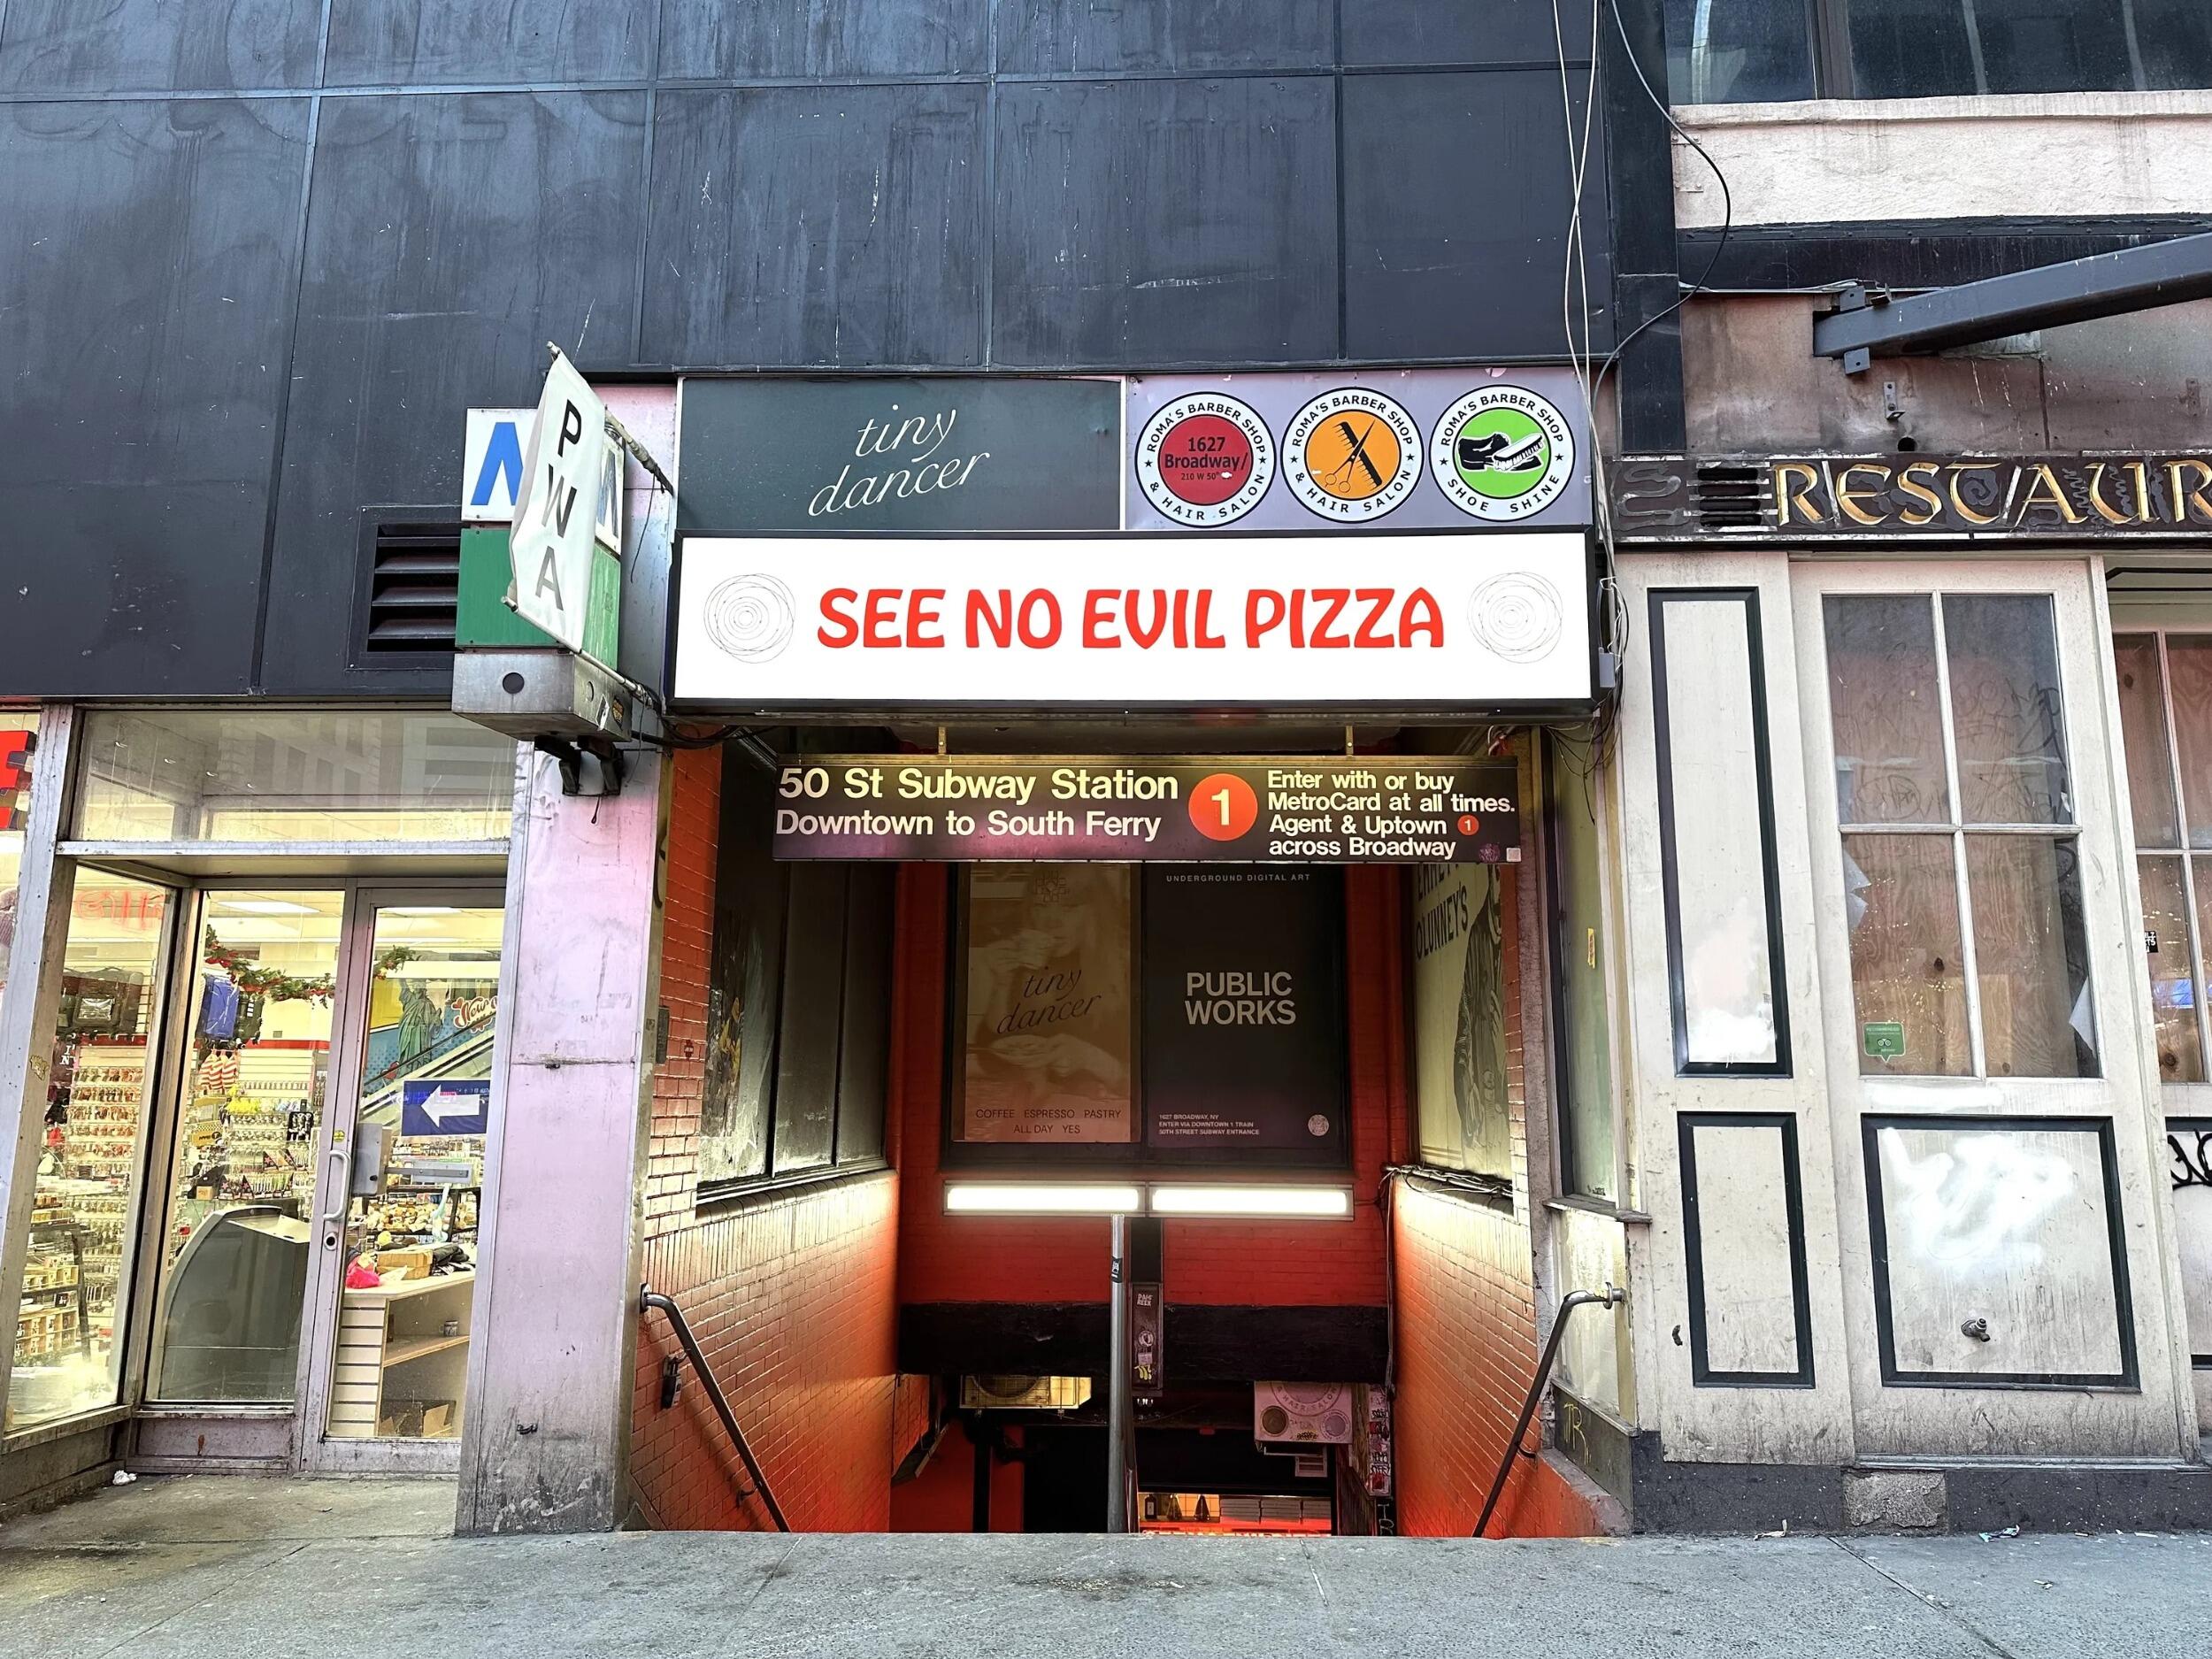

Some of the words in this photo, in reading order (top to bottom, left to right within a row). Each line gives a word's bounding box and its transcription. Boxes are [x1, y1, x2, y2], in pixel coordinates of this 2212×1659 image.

[855, 403, 956, 463] tiny
[1147, 408, 1184, 452] ROMA'S
[1187, 402, 1241, 421] BARBER
[1241, 419, 1266, 453] SHOP
[1292, 403, 1329, 447] ROMA'S
[1332, 395, 1386, 413] BARBER
[1387, 411, 1413, 445] SHOP
[1441, 401, 1477, 446] ROMA'S
[1480, 394, 1536, 411] BARBER
[1537, 409, 1563, 442] SHOP
[1188, 436, 1225, 452] 1627
[808, 452, 991, 517] dancer
[1150, 481, 1159, 493] &
[1162, 496, 1205, 520] HAIR
[1218, 474, 1265, 518] SALON
[1295, 472, 1305, 483] &
[1306, 488, 1349, 513] HAIR
[1363, 470, 1411, 511] SALON
[1448, 479, 1489, 511] SHOE
[1509, 474, 1560, 513] SHINE
[1772, 459, 2212, 533] RESTAUR
[534, 398, 582, 611] PWA
[817, 588, 947, 649] SEE
[965, 588, 1063, 649] NO
[1082, 588, 1226, 649] EVIL
[1245, 587, 1444, 649] PIZZA
[779, 767, 829, 798] 50
[843, 767, 884, 798] St
[898, 768, 1037, 805] Subway
[1051, 768, 1179, 800] Station
[1267, 770, 1323, 789] Enter
[1332, 770, 1377, 790] with
[1385, 775, 1408, 790] or
[1415, 772, 1455, 795] buy
[1211, 788, 1230, 826] 1
[1268, 792, 1381, 811] MetroCard
[1389, 795, 1411, 811] at
[1420, 794, 1443, 812] all
[1450, 795, 1516, 812] times.
[775, 809, 933, 835] Downtown
[946, 811, 976, 836] to
[987, 810, 1074, 836] South
[1086, 810, 1162, 842] Ferry
[1269, 814, 1332, 837] Agent
[1340, 815, 1356, 834] &
[1365, 815, 1447, 839] Uptown
[1269, 840, 1341, 856] across
[1349, 837, 1456, 860] Broadway
[1023, 965, 1082, 1002] tiny
[1187, 972, 1293, 997] PUBLIC
[996, 995, 1102, 1034] dancer
[1185, 1000, 1296, 1025] WORKS
[975, 1109, 1016, 1119] COFFEE
[1024, 1109, 1075, 1119] ESPRESSO
[1084, 1109, 1122, 1119] PASTRY
[1013, 1125, 1032, 1134] ALL
[1033, 1125, 1054, 1134] DAY
[1062, 1125, 1080, 1134] YES
[1282, 1395, 1306, 1412] HAIR
[1311, 1386, 1337, 1409] SALON
